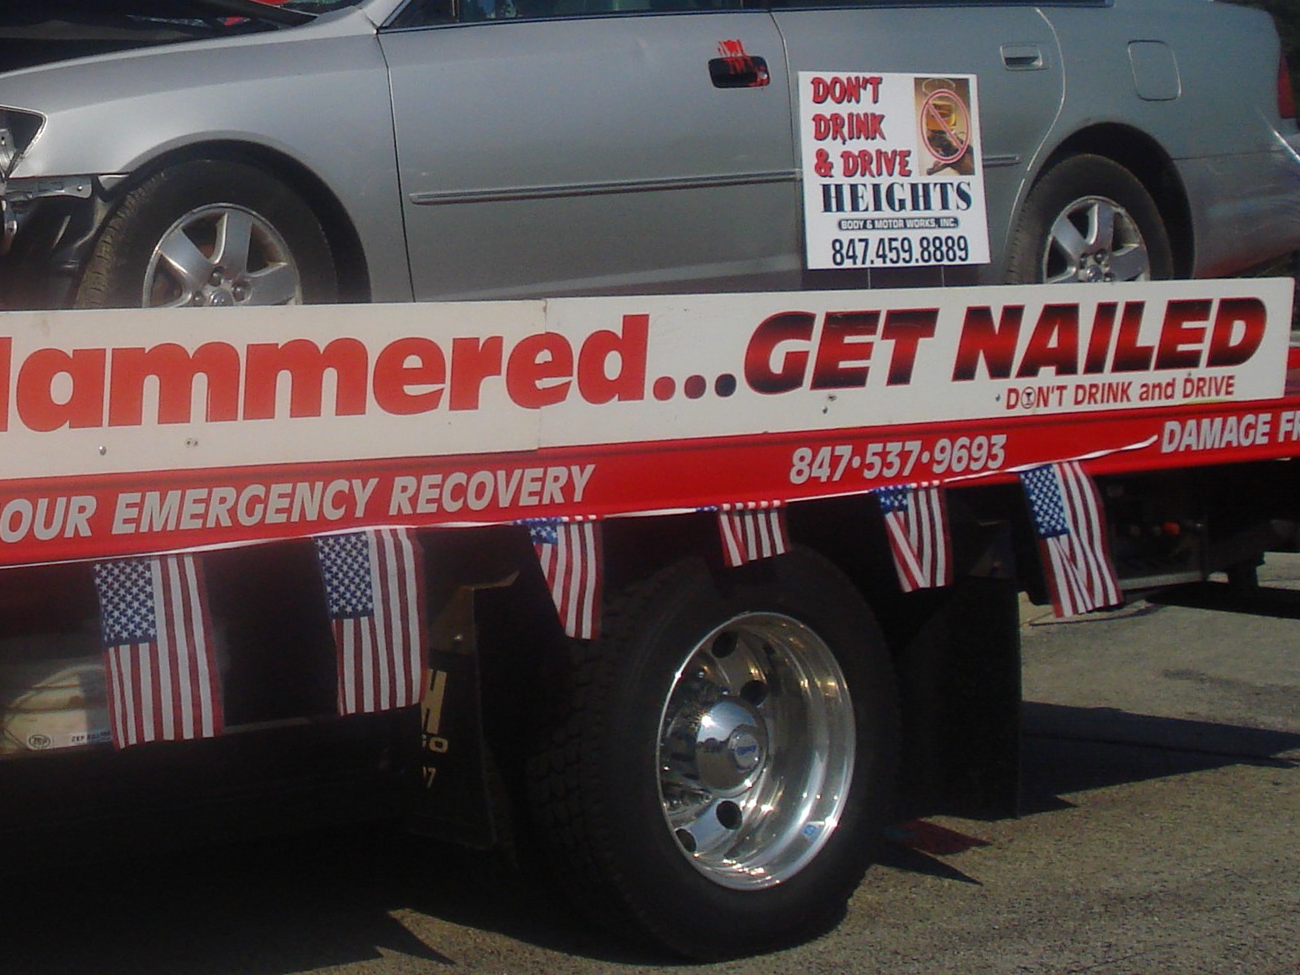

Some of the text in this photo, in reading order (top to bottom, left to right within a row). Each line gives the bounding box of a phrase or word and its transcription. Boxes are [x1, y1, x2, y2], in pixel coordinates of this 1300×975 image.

[810, 76, 883, 104] DON'T
[812, 112, 886, 145] DRINK
[814, 148, 913, 178] & DRIVE
[820, 181, 972, 213] HEIGHTS
[840, 220, 864, 230] BODY
[874, 219, 904, 229] MOTOR
[940, 217, 958, 228] INC.
[831, 235, 970, 266] 847.459.8889
[743, 308, 940, 394] GET
[951, 297, 1267, 382] NAILED
[1005, 375, 1235, 410] DON'T DRINK and DRIVE
[1161, 412, 1273, 454] DAMAGE
[111, 478, 379, 535] EMERGENCY
[388, 464, 596, 516] RECOVERY
